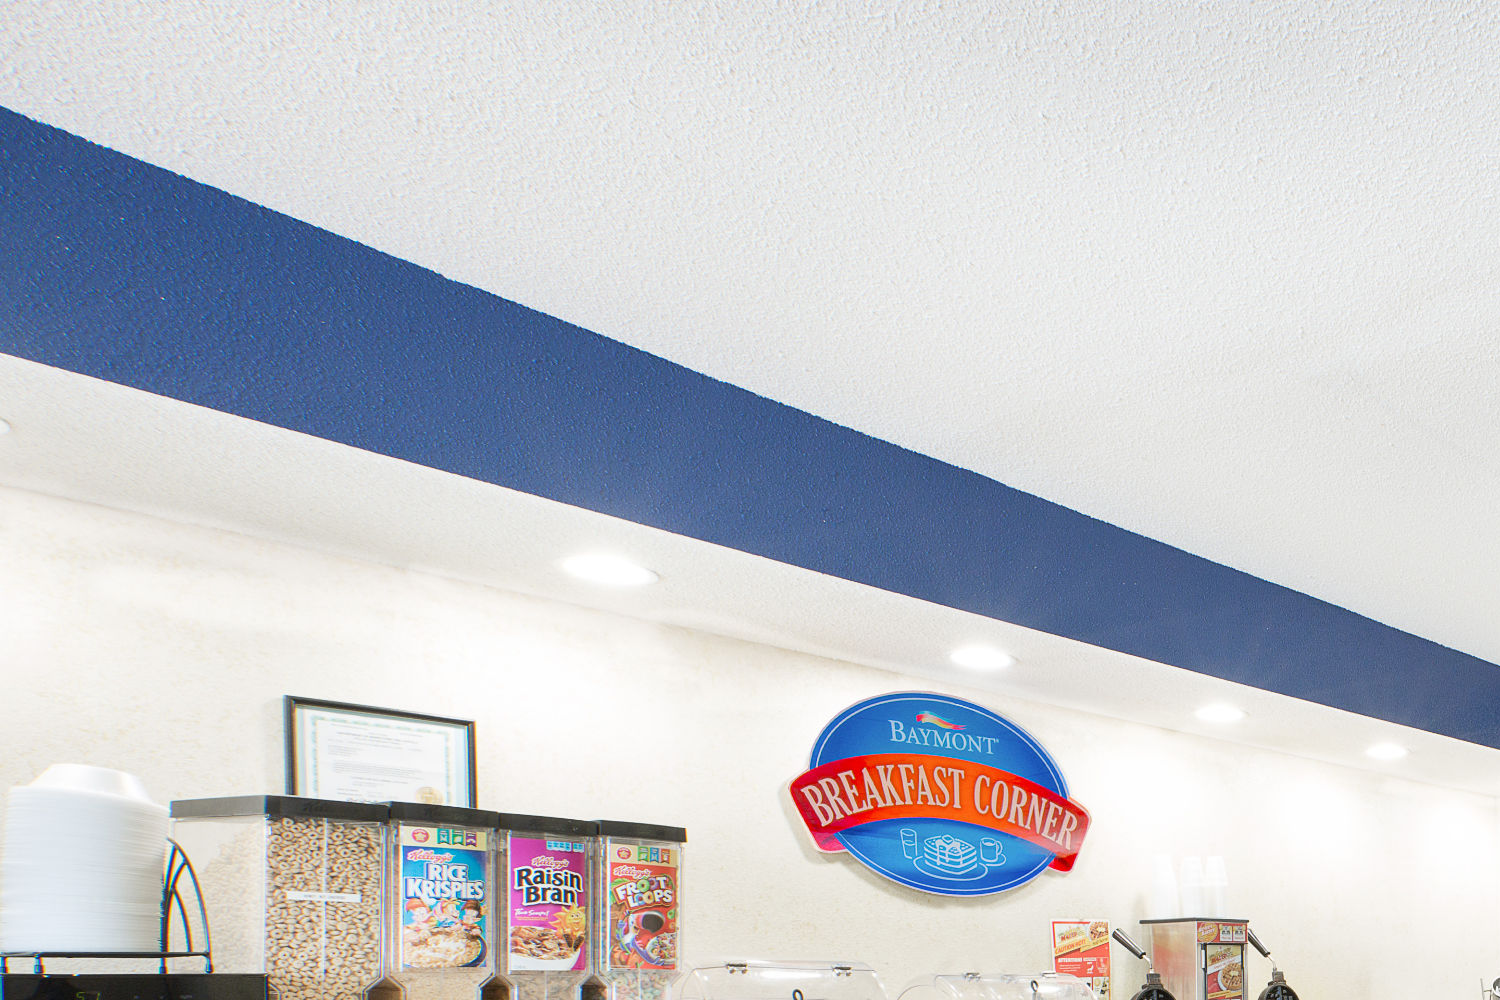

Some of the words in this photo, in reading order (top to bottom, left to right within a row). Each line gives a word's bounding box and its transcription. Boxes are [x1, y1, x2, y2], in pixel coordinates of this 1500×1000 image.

[888, 719, 996, 755] BAYMONT
[801, 764, 965, 827] BREAKFAST
[974, 774, 1079, 851] CORNER
[426, 863, 468, 881] RICE
[516, 868, 582, 890] Raisin
[405, 878, 484, 901] KRISPIES
[525, 886, 577, 904] Bran
[616, 876, 668, 901] FROOT
[627, 889, 673, 908] LOOPS
